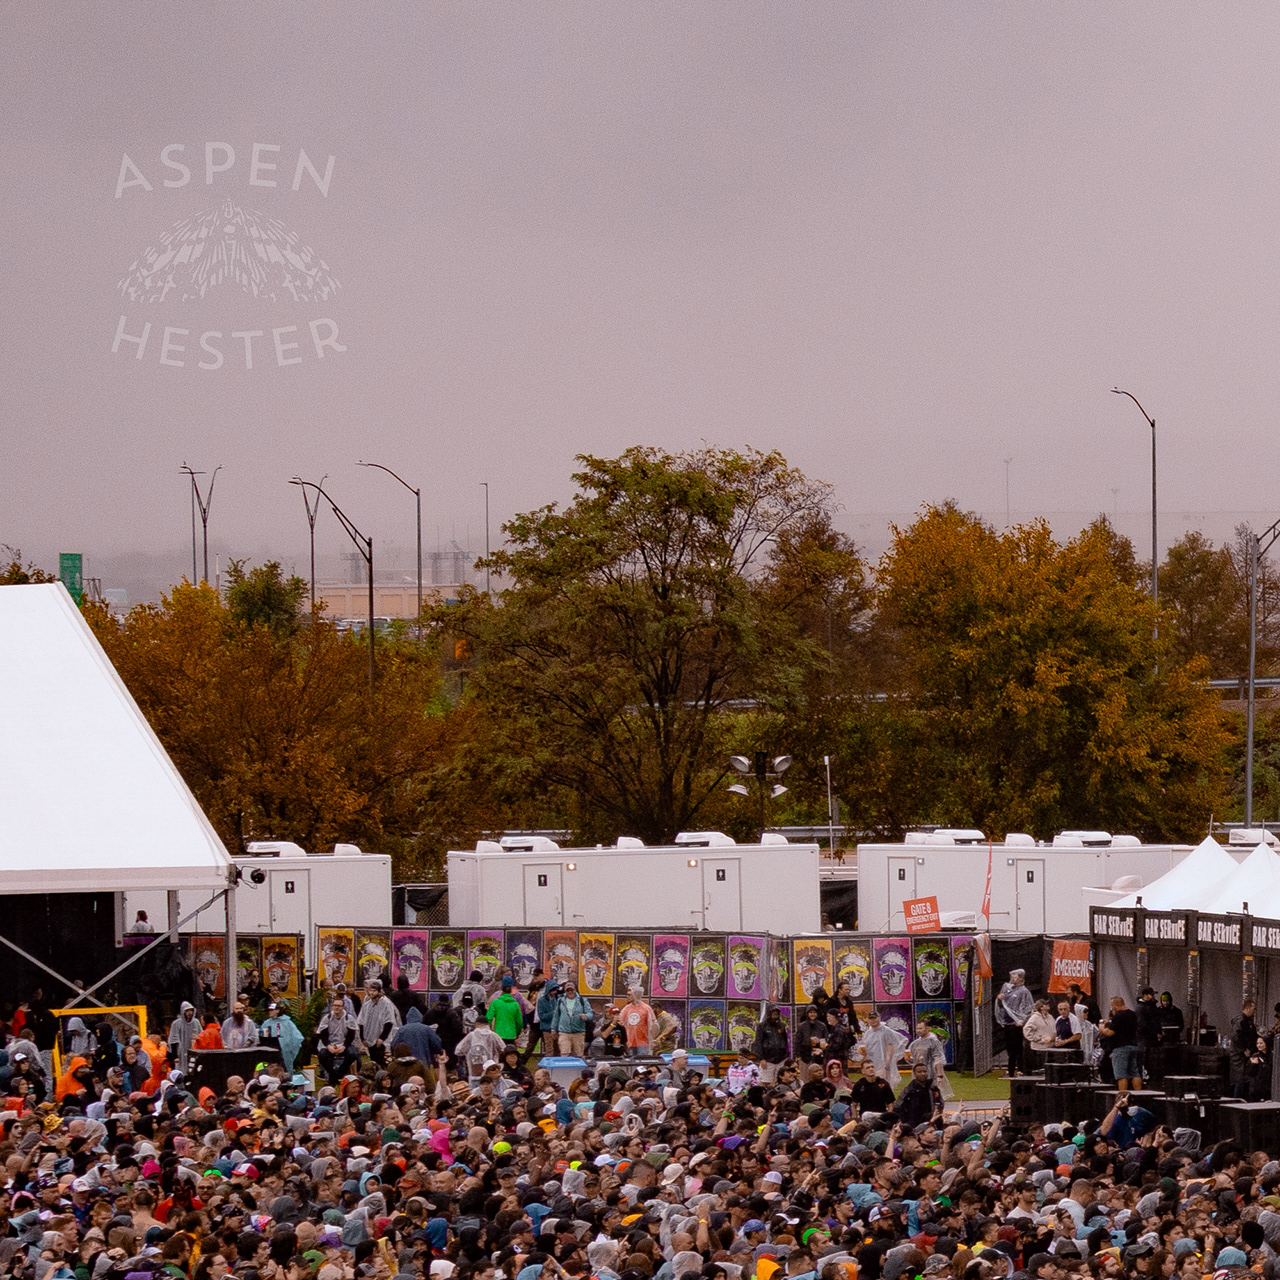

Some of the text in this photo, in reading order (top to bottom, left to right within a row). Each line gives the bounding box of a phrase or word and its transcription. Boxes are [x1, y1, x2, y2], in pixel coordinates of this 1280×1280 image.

[911, 902, 932, 916] GATE 8
[1094, 914, 1134, 937] BAR SERVICE
[1145, 918, 1185, 940] BAR SERVICE
[1198, 921, 1240, 945] BAR SERVICE
[1252, 926, 1267, 947] BAR
